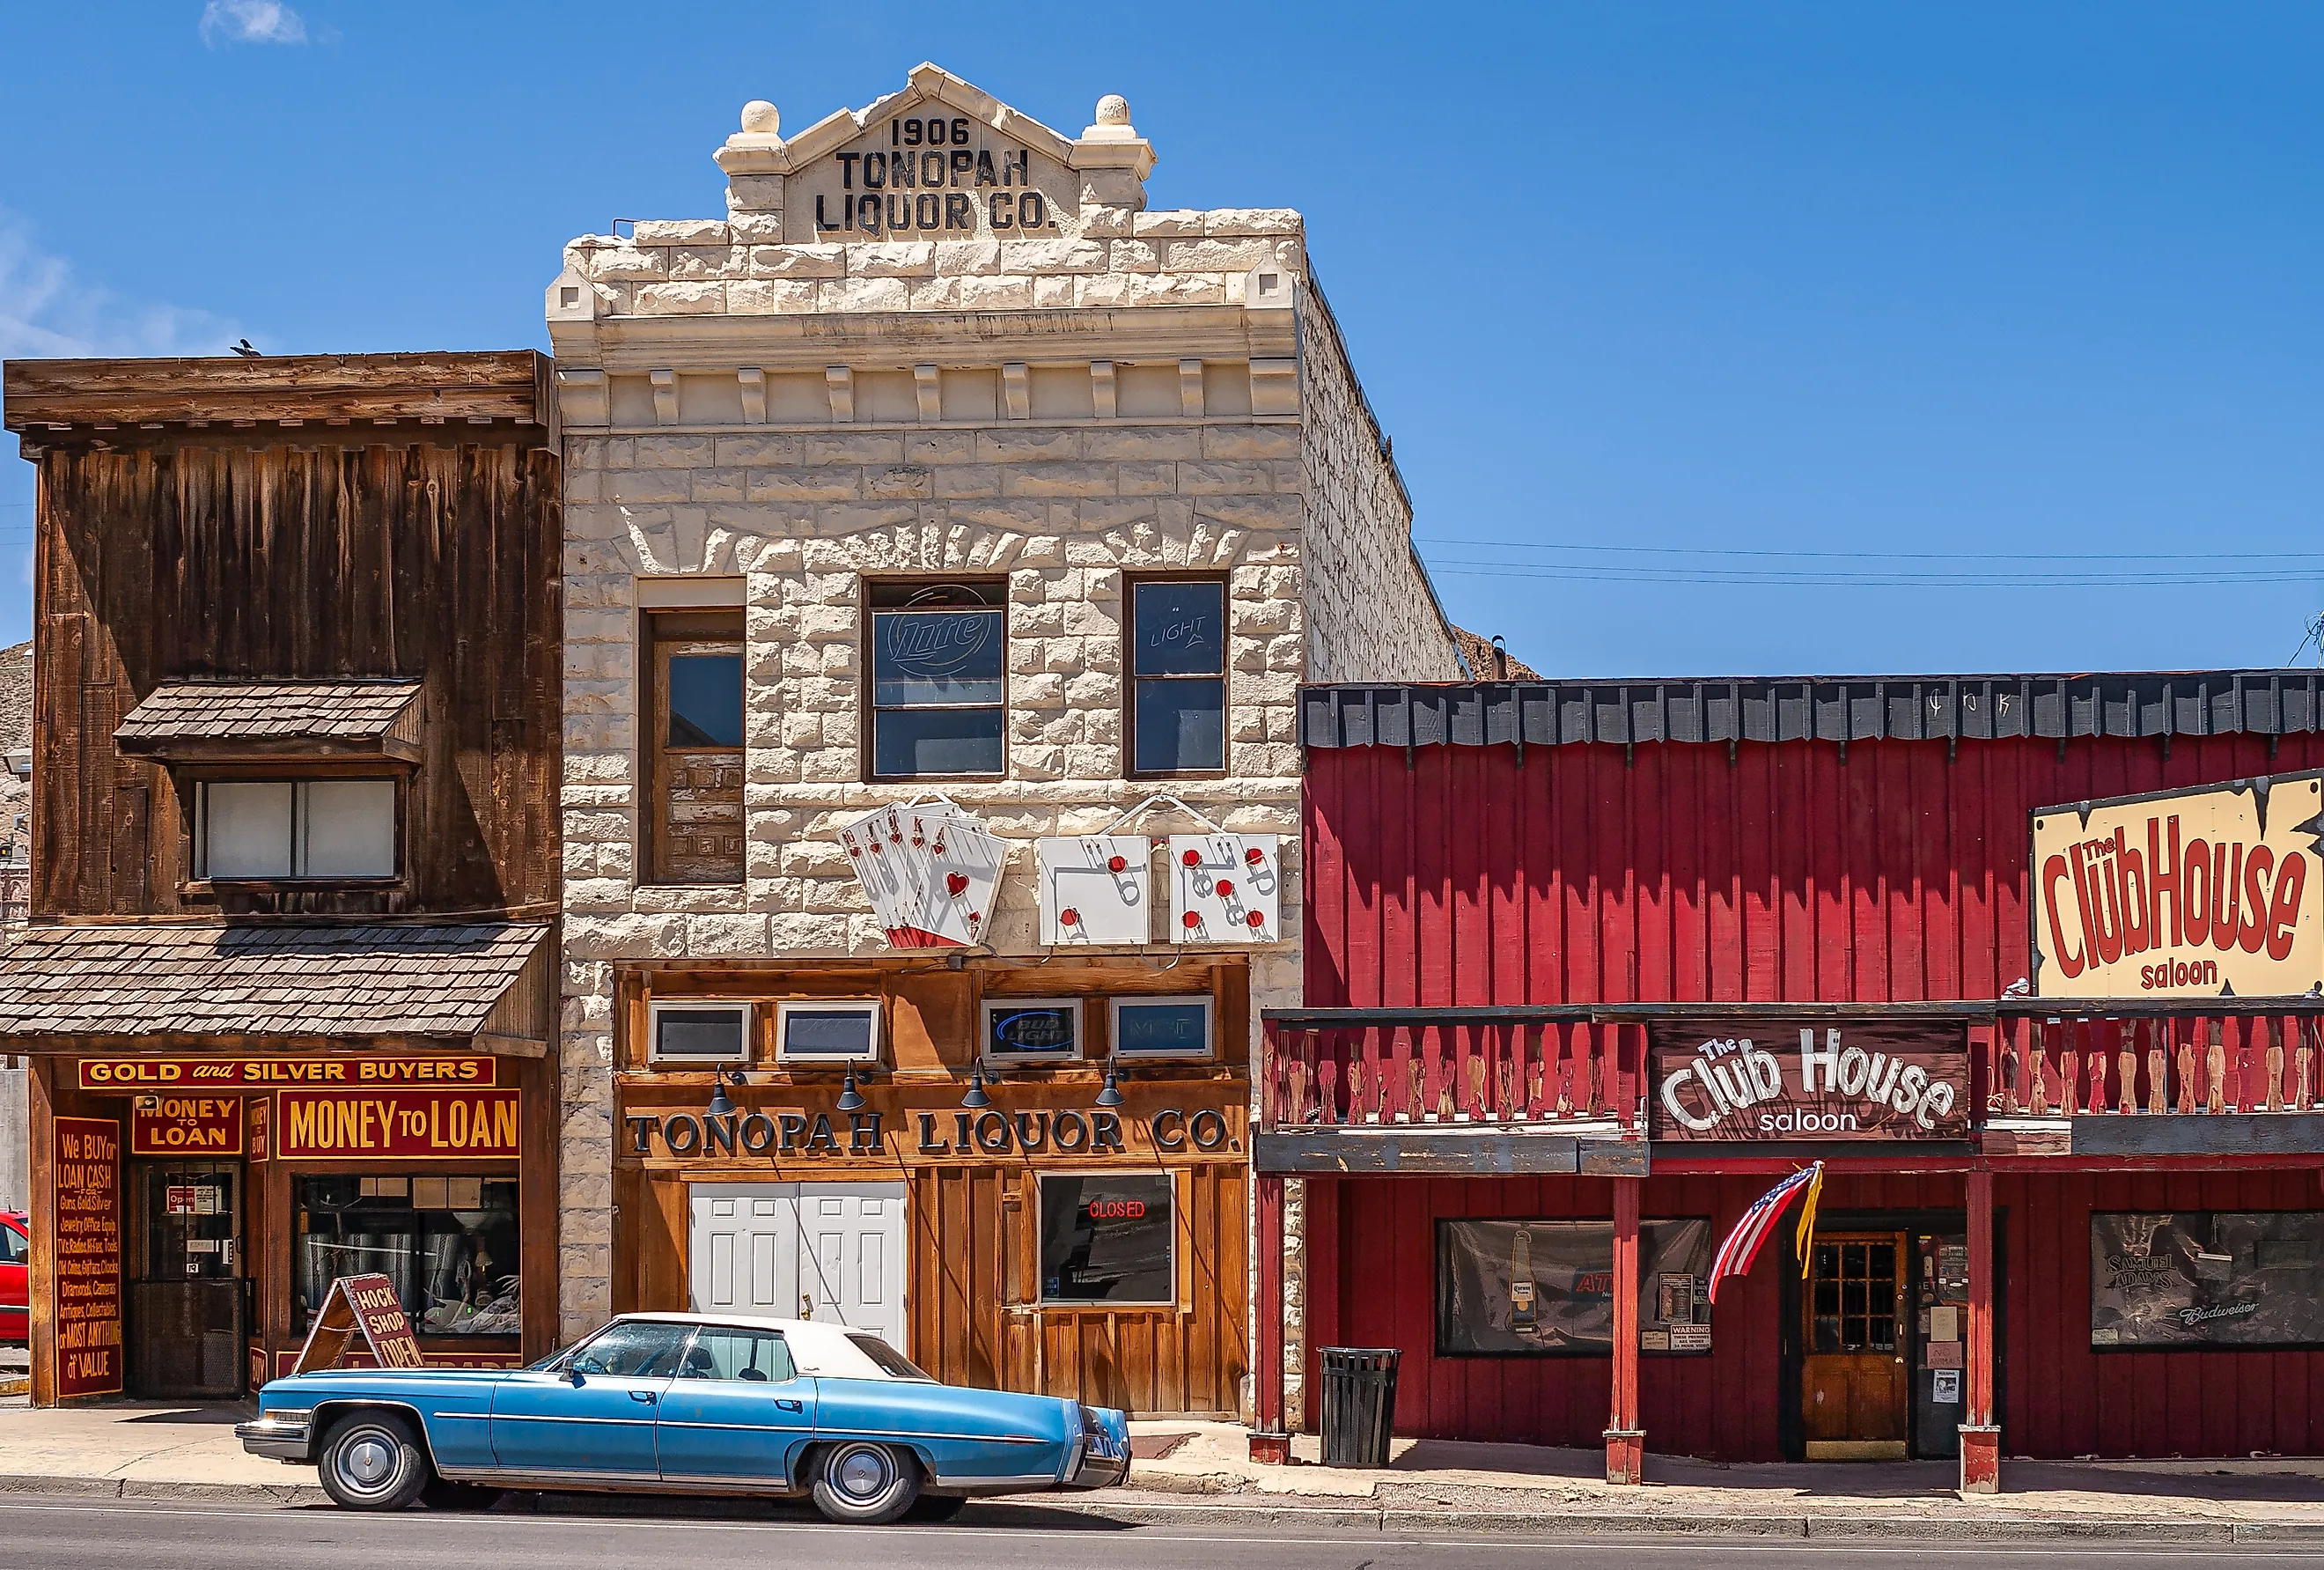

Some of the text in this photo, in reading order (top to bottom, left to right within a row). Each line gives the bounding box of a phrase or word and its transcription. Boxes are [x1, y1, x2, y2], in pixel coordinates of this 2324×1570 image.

[892, 118, 970, 146] 1906
[835, 149, 1029, 189] TONOPAH
[815, 191, 1056, 234] LIQUOR CO.
[1151, 615, 1207, 647] LIGHT
[2082, 837, 2114, 861] The
[2140, 957, 2217, 990] saloon
[1697, 1036, 1737, 1062] The
[90, 1061, 479, 1080] GOLD and SILVER BUYERS
[1660, 1028, 1955, 1131] Club House
[290, 1100, 517, 1148] MONEY TO LOAN
[625, 1109, 1240, 1152] TONOPAH LIQUOR CO.
[1759, 1108, 1857, 1131] saloon
[62, 1133, 116, 1160] We BUY or
[151, 1127, 226, 1145] LOAN
[252, 1135, 266, 1154] BUY
[57, 1163, 112, 1189] LOAN CASH
[1089, 1200, 1146, 1218] CLOSED
[2107, 1254, 2178, 1276] SAMUEL
[1576, 1273, 1614, 1292] AT
[2114, 1271, 2173, 1290] ADAMS
[356, 1286, 397, 1310] HOCK
[368, 1310, 405, 1335] SHOP
[2179, 1303, 2260, 1324] Budweiser
[66, 1322, 85, 1349] MOST
[380, 1335, 423, 1367] OPEN
[67, 1351, 109, 1380] of VALUE
[252, 1355, 265, 1386] BUY
